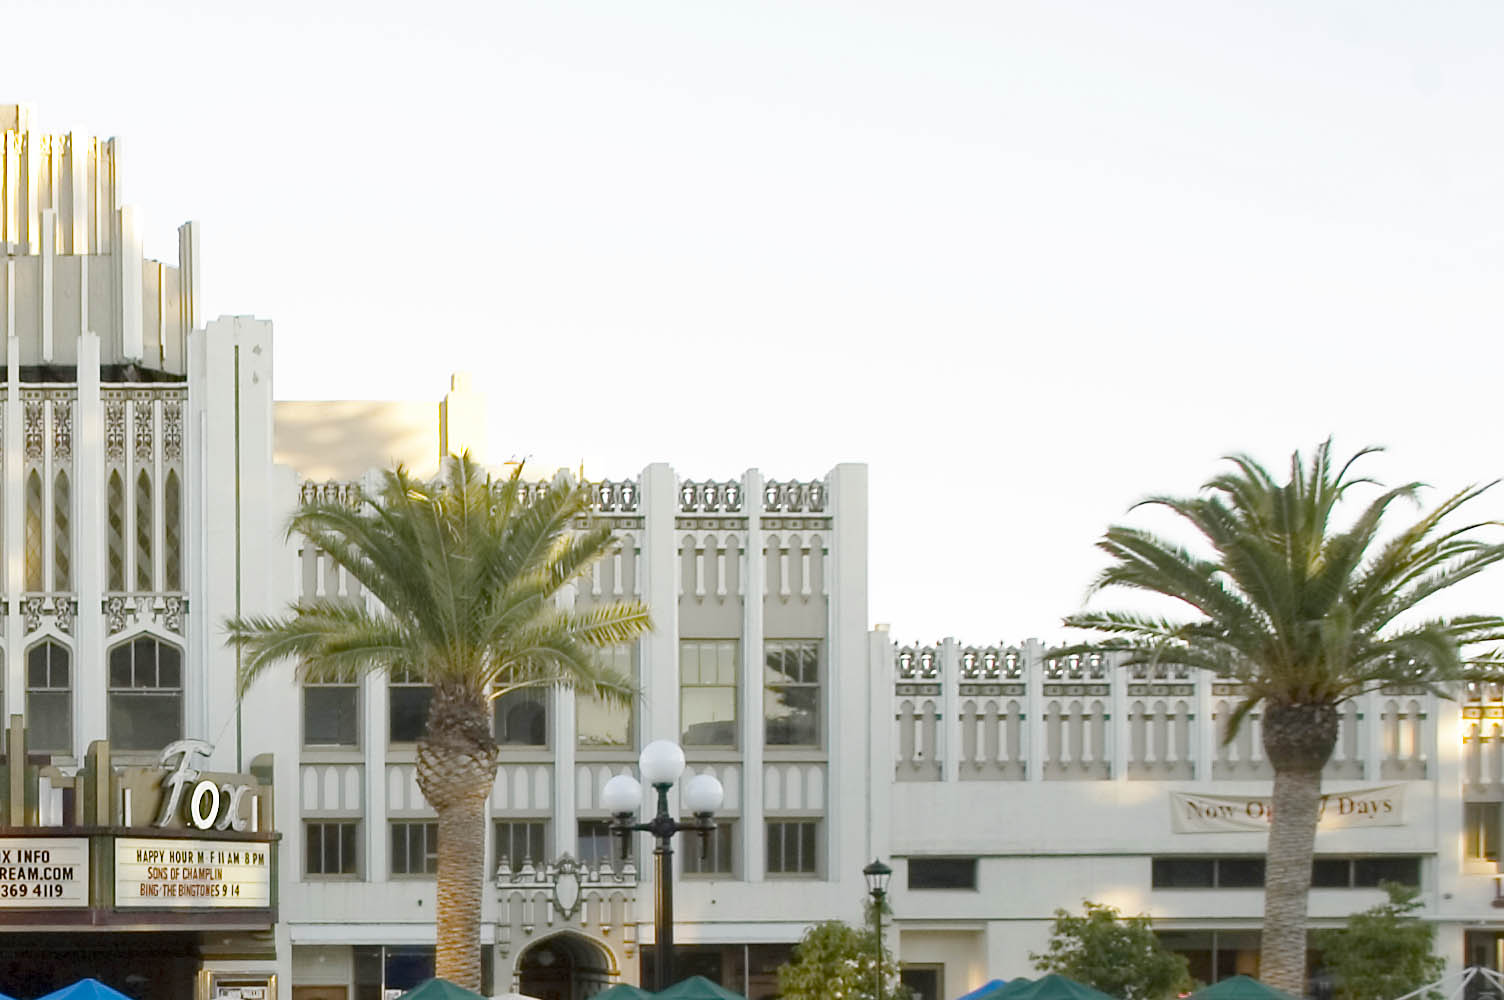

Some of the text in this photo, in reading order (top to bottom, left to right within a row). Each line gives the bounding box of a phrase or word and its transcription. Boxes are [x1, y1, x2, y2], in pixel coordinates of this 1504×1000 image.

[158, 739, 255, 831] Fox
[1187, 800, 1233, 820] Now
[1338, 796, 1393, 819] Days
[17, 850, 50, 863] INFO
[136, 849, 164, 863] HAPPY
[169, 850, 194, 864] HOUR
[148, 867, 223, 881] SONS OF CHAMPLIN
[1, 884, 28, 897] 369
[32, 884, 63, 897] 4119
[178, 884, 220, 897] BINGTONES
